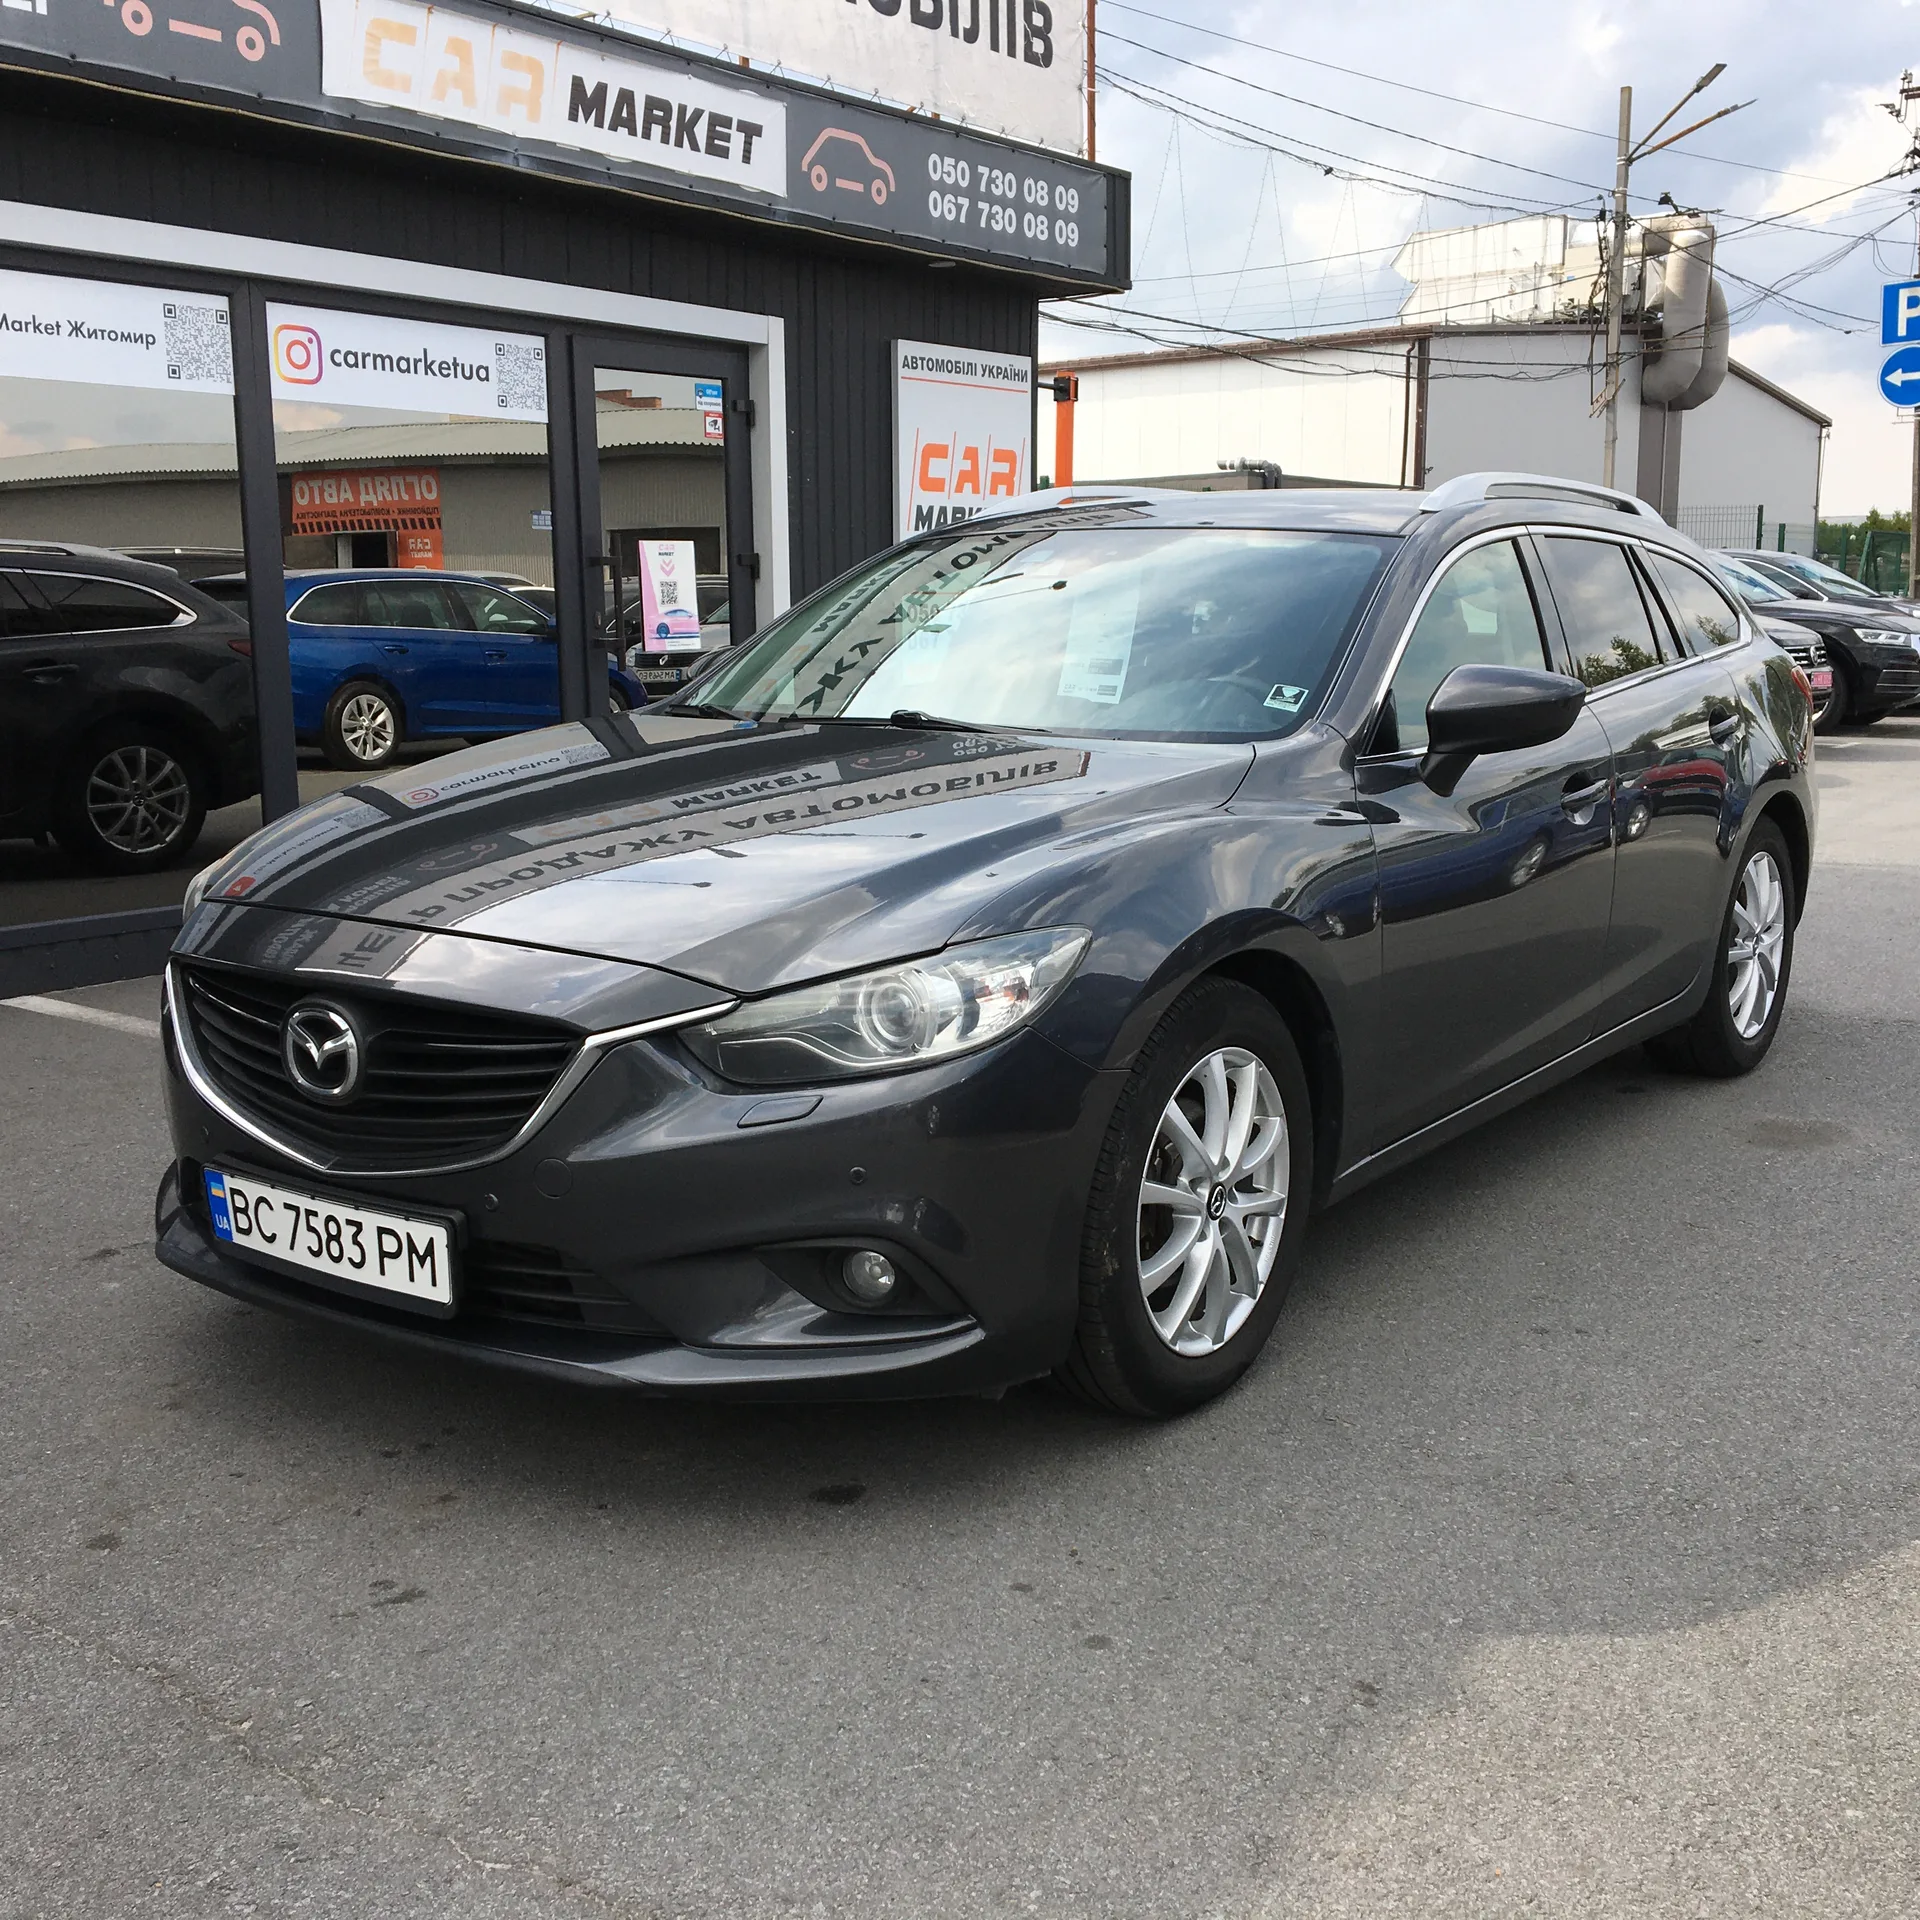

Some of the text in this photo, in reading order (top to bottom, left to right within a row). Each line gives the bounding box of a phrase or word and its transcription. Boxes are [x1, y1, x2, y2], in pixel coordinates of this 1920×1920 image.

[363, 18, 763, 165] CAR MARKET
[928, 153, 1079, 214] 050 730 08 09
[928, 190, 1079, 248] 067 730 08 09
[66, 319, 156, 350] Житомир
[1897, 286, 1920, 337] P
[329, 347, 490, 382] carmarketua
[902, 355, 1028, 383] АВТОМОБІЛІ УКРАЇНИ
[918, 442, 1018, 497] CAR
[215, 1187, 438, 1287] UA BC 7583 PM
